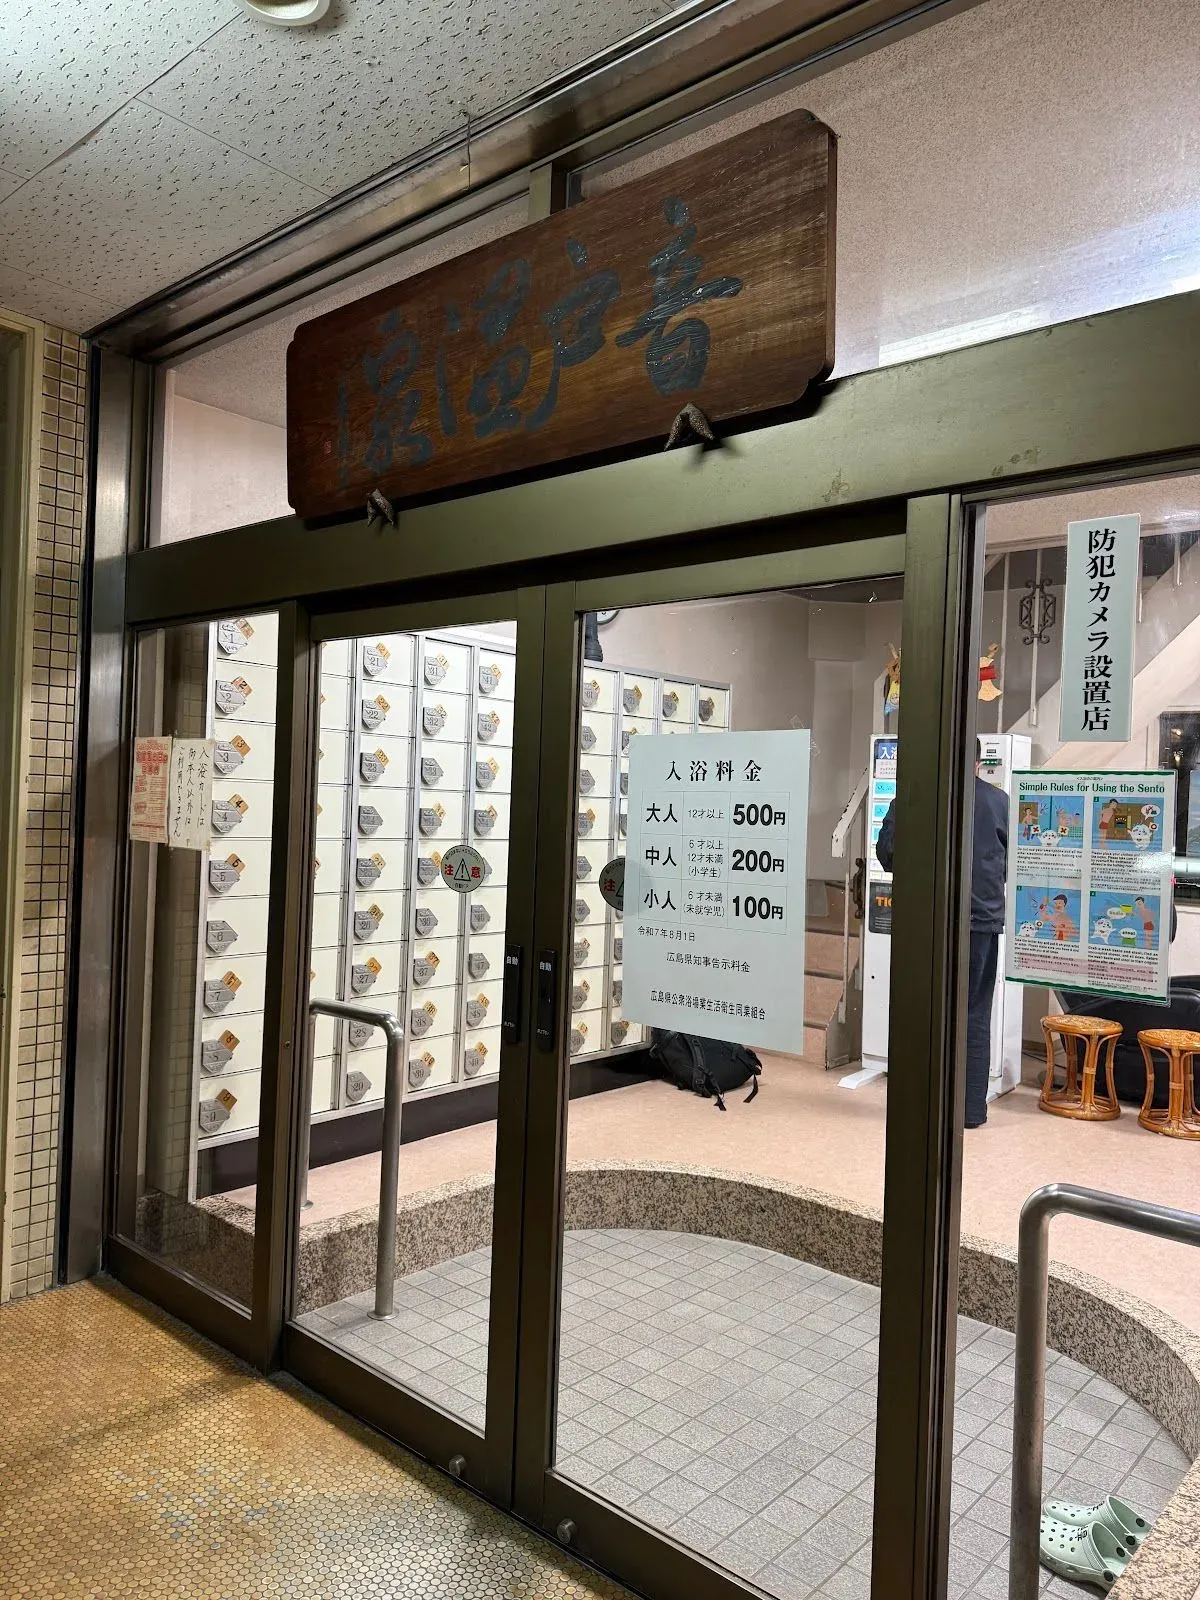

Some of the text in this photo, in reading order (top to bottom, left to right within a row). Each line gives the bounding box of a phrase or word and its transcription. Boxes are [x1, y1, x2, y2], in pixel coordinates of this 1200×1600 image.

[1080, 528, 1117, 732] 防犯カメラ設置店
[665, 760, 762, 782] 入浴料金
[1019, 782, 1165, 793] Simple Rules for Using the Sento
[646, 803, 678, 824] 大人
[687, 808, 724, 820] 12才以上
[733, 804, 786, 826] 500円
[644, 845, 677, 867] 中人
[687, 852, 724, 865] 12才未満
[732, 850, 784, 873] 200円
[687, 865, 722, 878] (小学生)
[604, 879, 617, 892] 注
[643, 888, 677, 911] 小人
[683, 902, 725, 917] (未就学児)
[732, 895, 784, 920] 100円
[637, 926, 696, 942] 令和7年8月1日
[506, 955, 519, 966] 自動
[539, 961, 552, 972] 自動
[666, 951, 751, 973] 広島県知事告示料金
[650, 990, 766, 1021] 広島県公衆浴場業生活衛生同業組合
